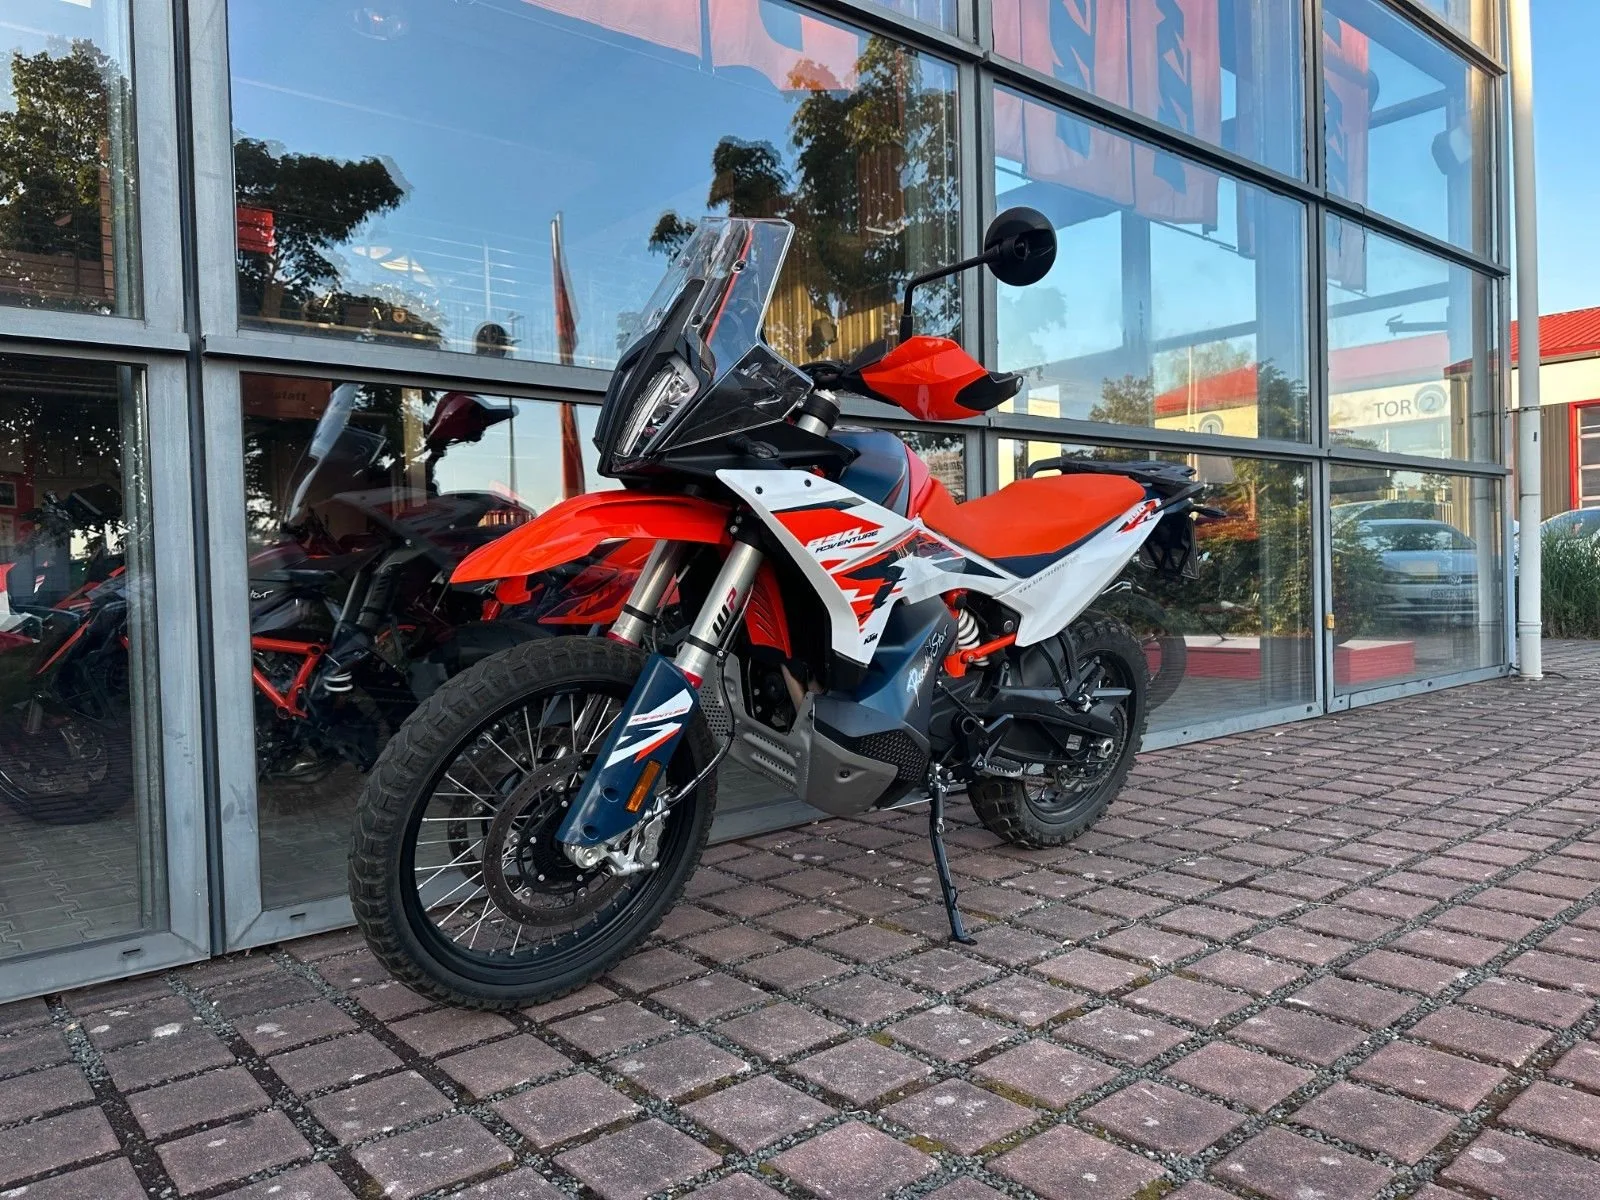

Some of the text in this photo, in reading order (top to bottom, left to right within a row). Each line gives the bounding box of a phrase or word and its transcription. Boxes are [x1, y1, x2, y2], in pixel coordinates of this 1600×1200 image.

[1373, 399, 1412, 418] TOR
[815, 530, 879, 554] ADVENTURE
[863, 632, 878, 645] KTM
